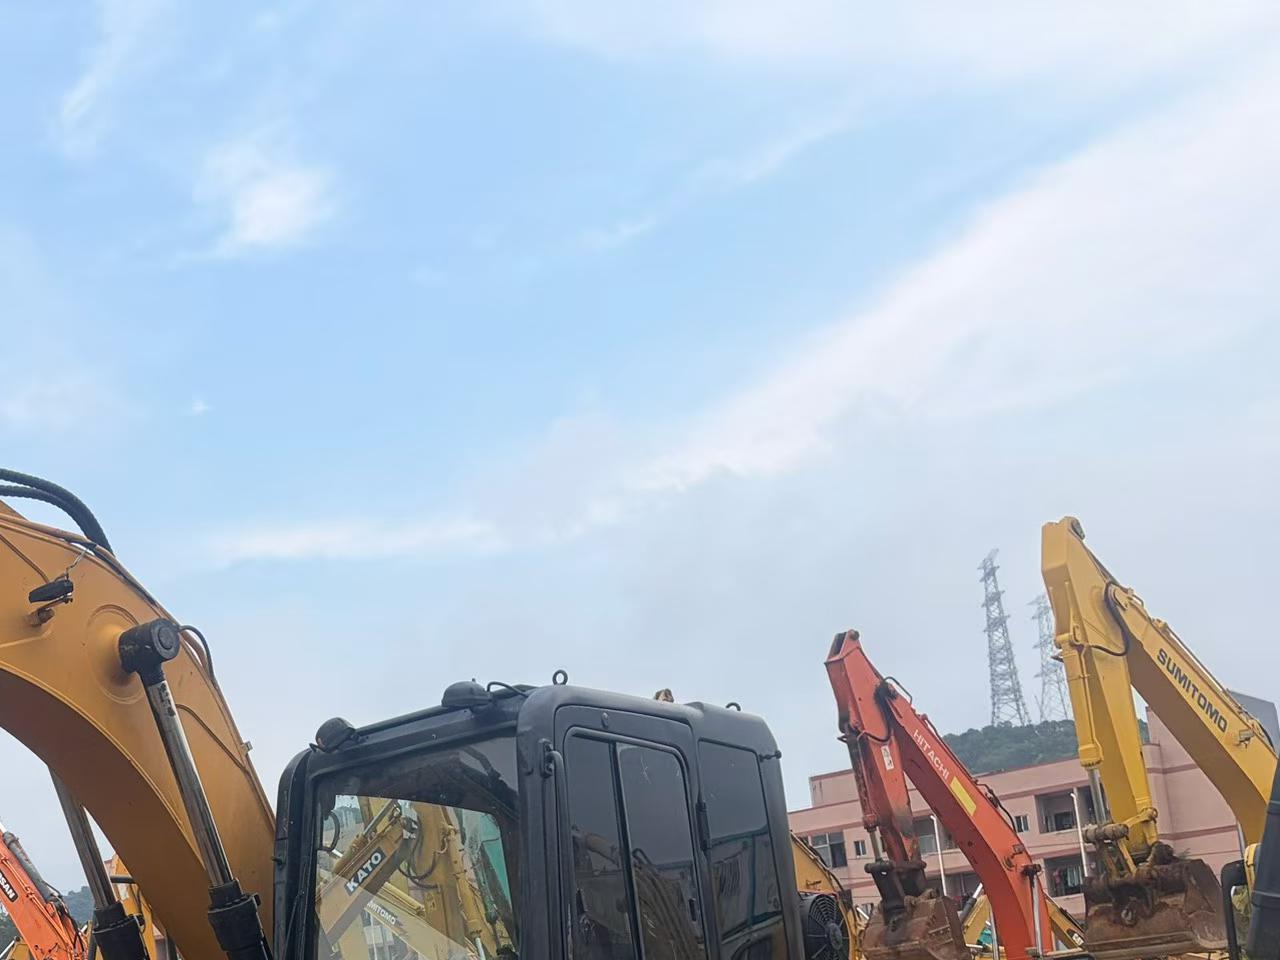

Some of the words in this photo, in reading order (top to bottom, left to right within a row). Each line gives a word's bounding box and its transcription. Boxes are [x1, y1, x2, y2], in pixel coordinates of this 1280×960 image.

[1157, 648, 1228, 733] SUMITOMO
[913, 729, 949, 779] HITACHI
[346, 852, 382, 892] KATO
